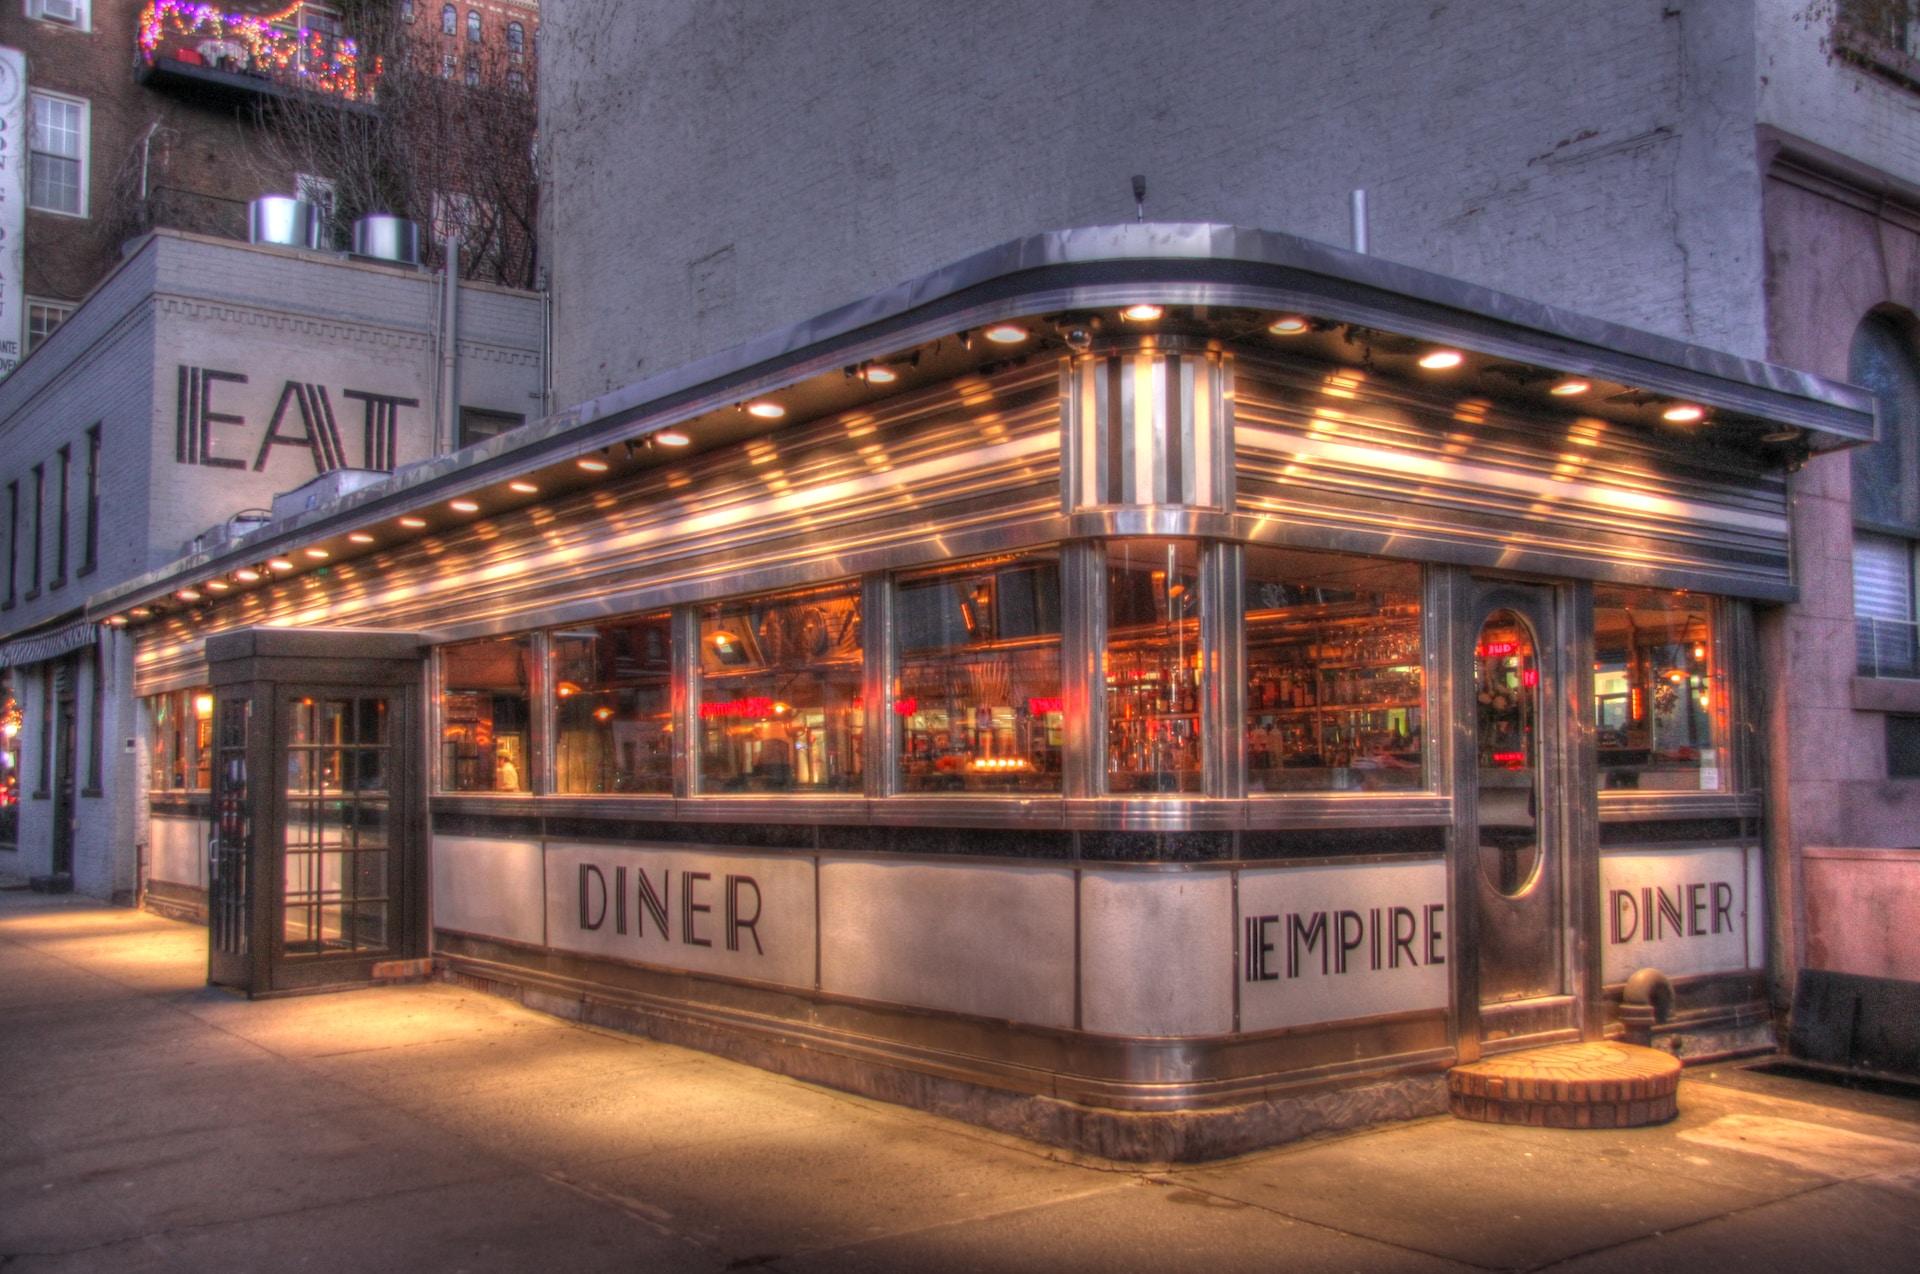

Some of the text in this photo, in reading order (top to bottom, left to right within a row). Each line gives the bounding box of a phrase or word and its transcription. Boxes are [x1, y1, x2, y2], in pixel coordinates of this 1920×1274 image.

[176, 364, 420, 474] EAT
[579, 863, 764, 956] DINER
[1244, 903, 1446, 983] EMPIRE
[1609, 881, 1734, 945] DINER
